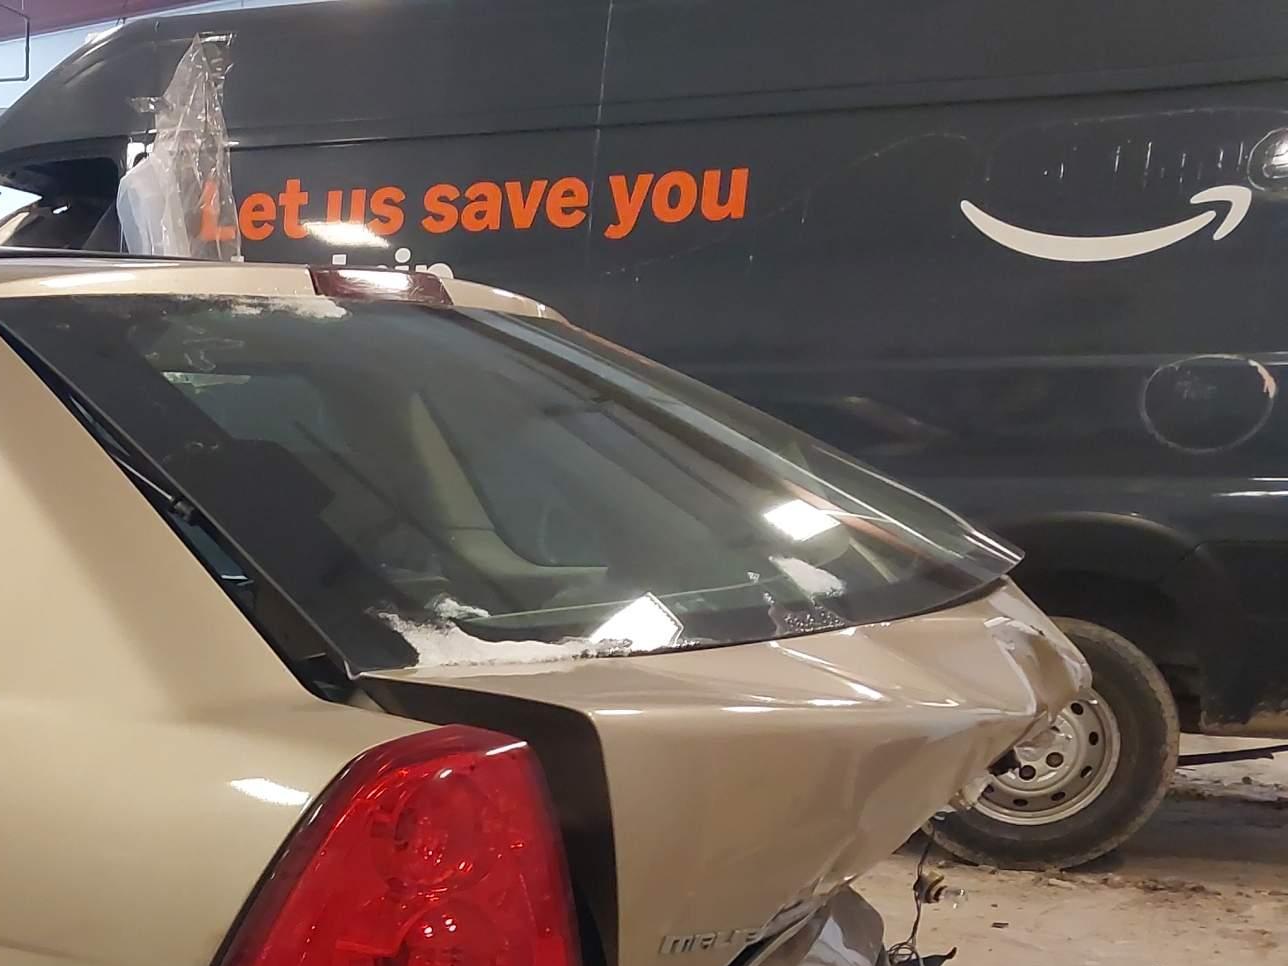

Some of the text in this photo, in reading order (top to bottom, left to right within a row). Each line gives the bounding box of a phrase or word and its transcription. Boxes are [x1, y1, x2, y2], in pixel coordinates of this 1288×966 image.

[200, 167, 750, 241] Let us save you
